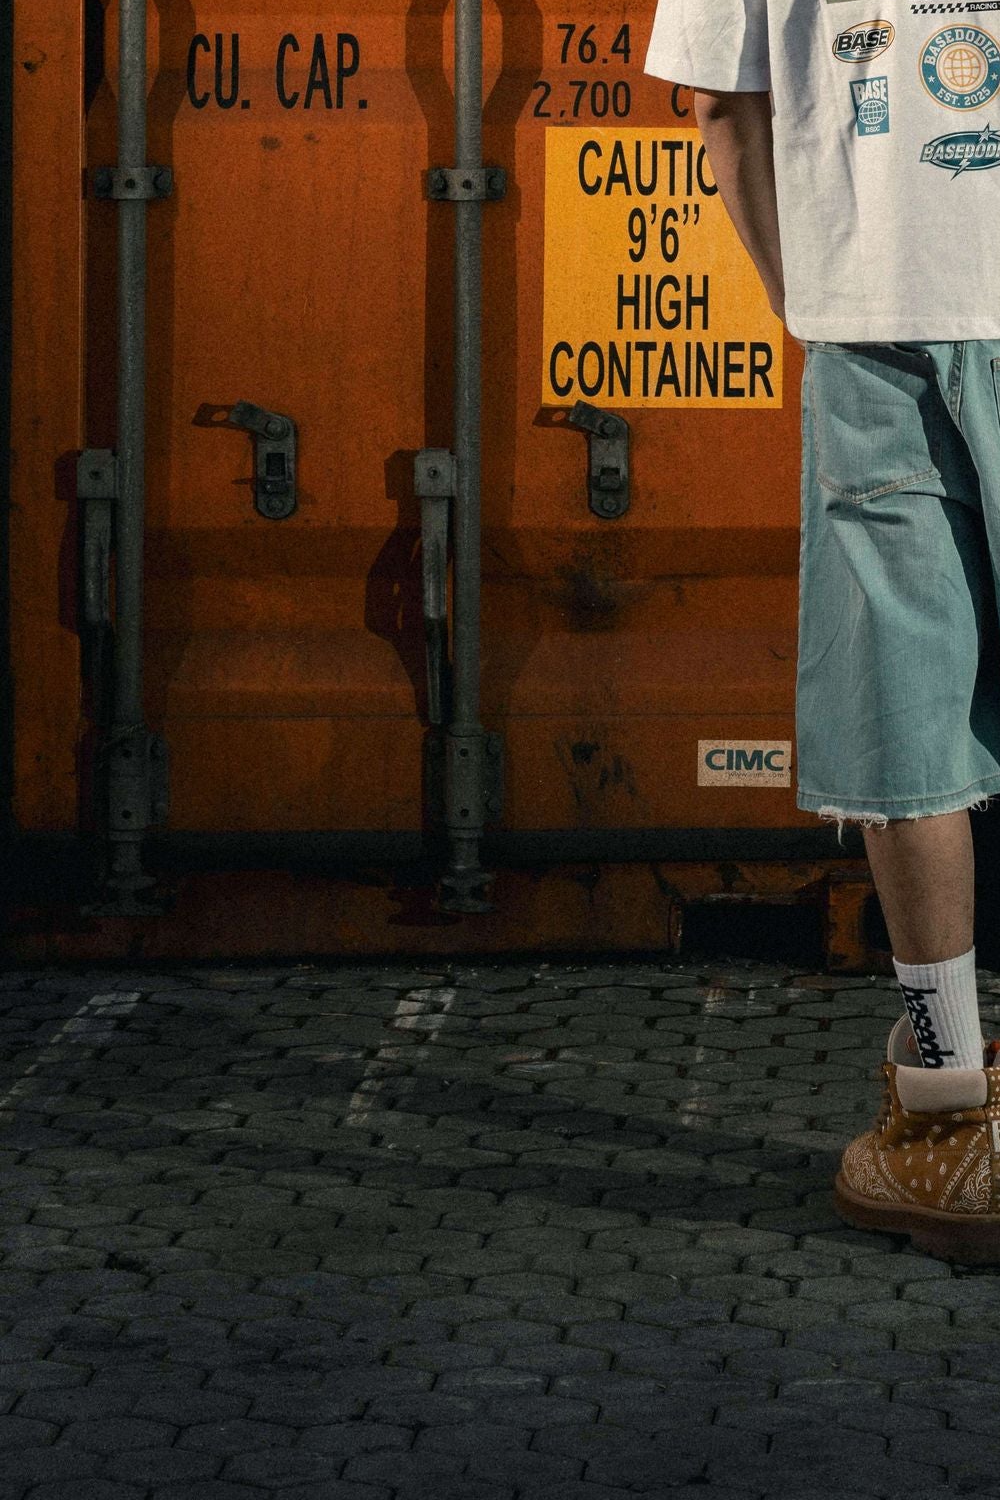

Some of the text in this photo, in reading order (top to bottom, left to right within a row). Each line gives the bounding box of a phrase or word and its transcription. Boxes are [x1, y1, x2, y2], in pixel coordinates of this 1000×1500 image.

[968, 2, 998, 11] RACING
[836, 28, 890, 53] BASE
[923, 26, 1000, 67] BASEDODICI
[186, 24, 631, 109] CU. CAP. 76.4
[852, 80, 888, 106] BASE
[936, 85, 991, 106] EST. 2025
[578, 140, 720, 197] CAUTIO
[616, 274, 709, 331] HIGH
[549, 340, 775, 398] CONTAINER
[705, 749, 785, 772] CIMC
